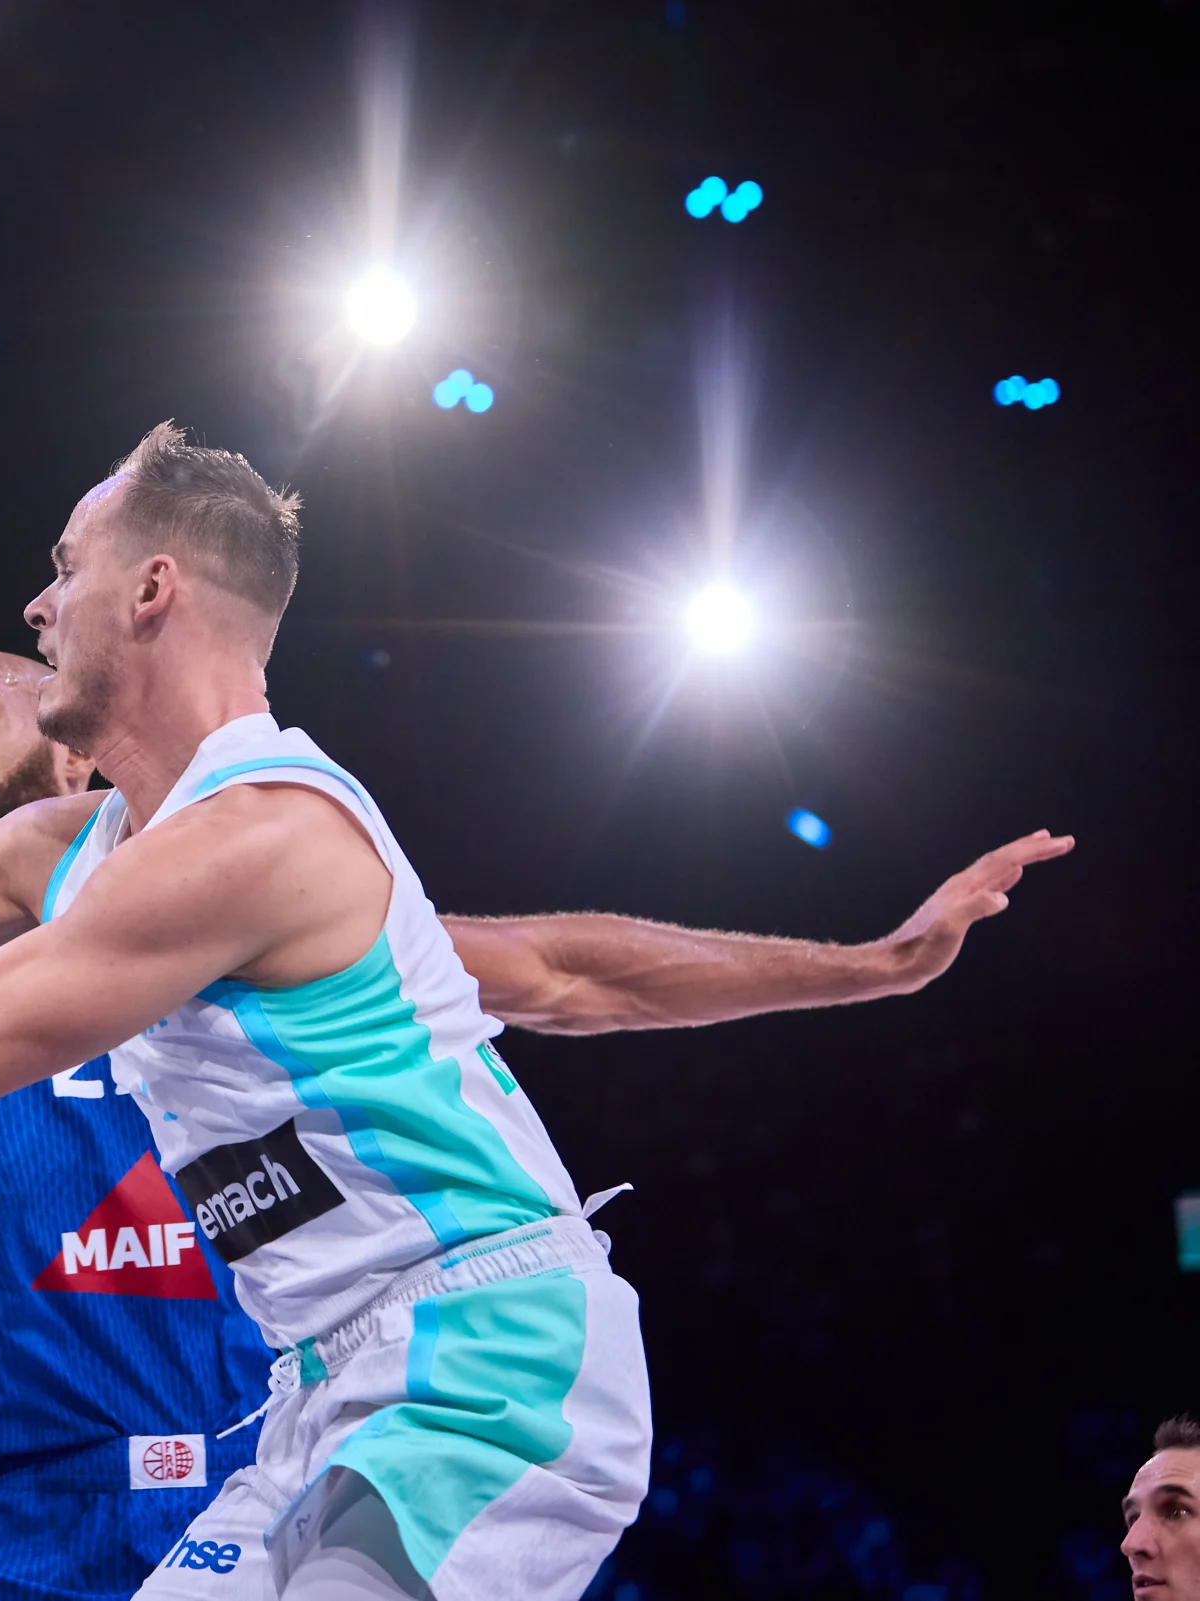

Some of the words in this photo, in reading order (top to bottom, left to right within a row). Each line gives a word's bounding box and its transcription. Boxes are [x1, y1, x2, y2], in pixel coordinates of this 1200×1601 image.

[61, 1222, 196, 1275] MAIF
[165, 1441, 175, 1480] FRA
[165, 1532, 242, 1574] hse
